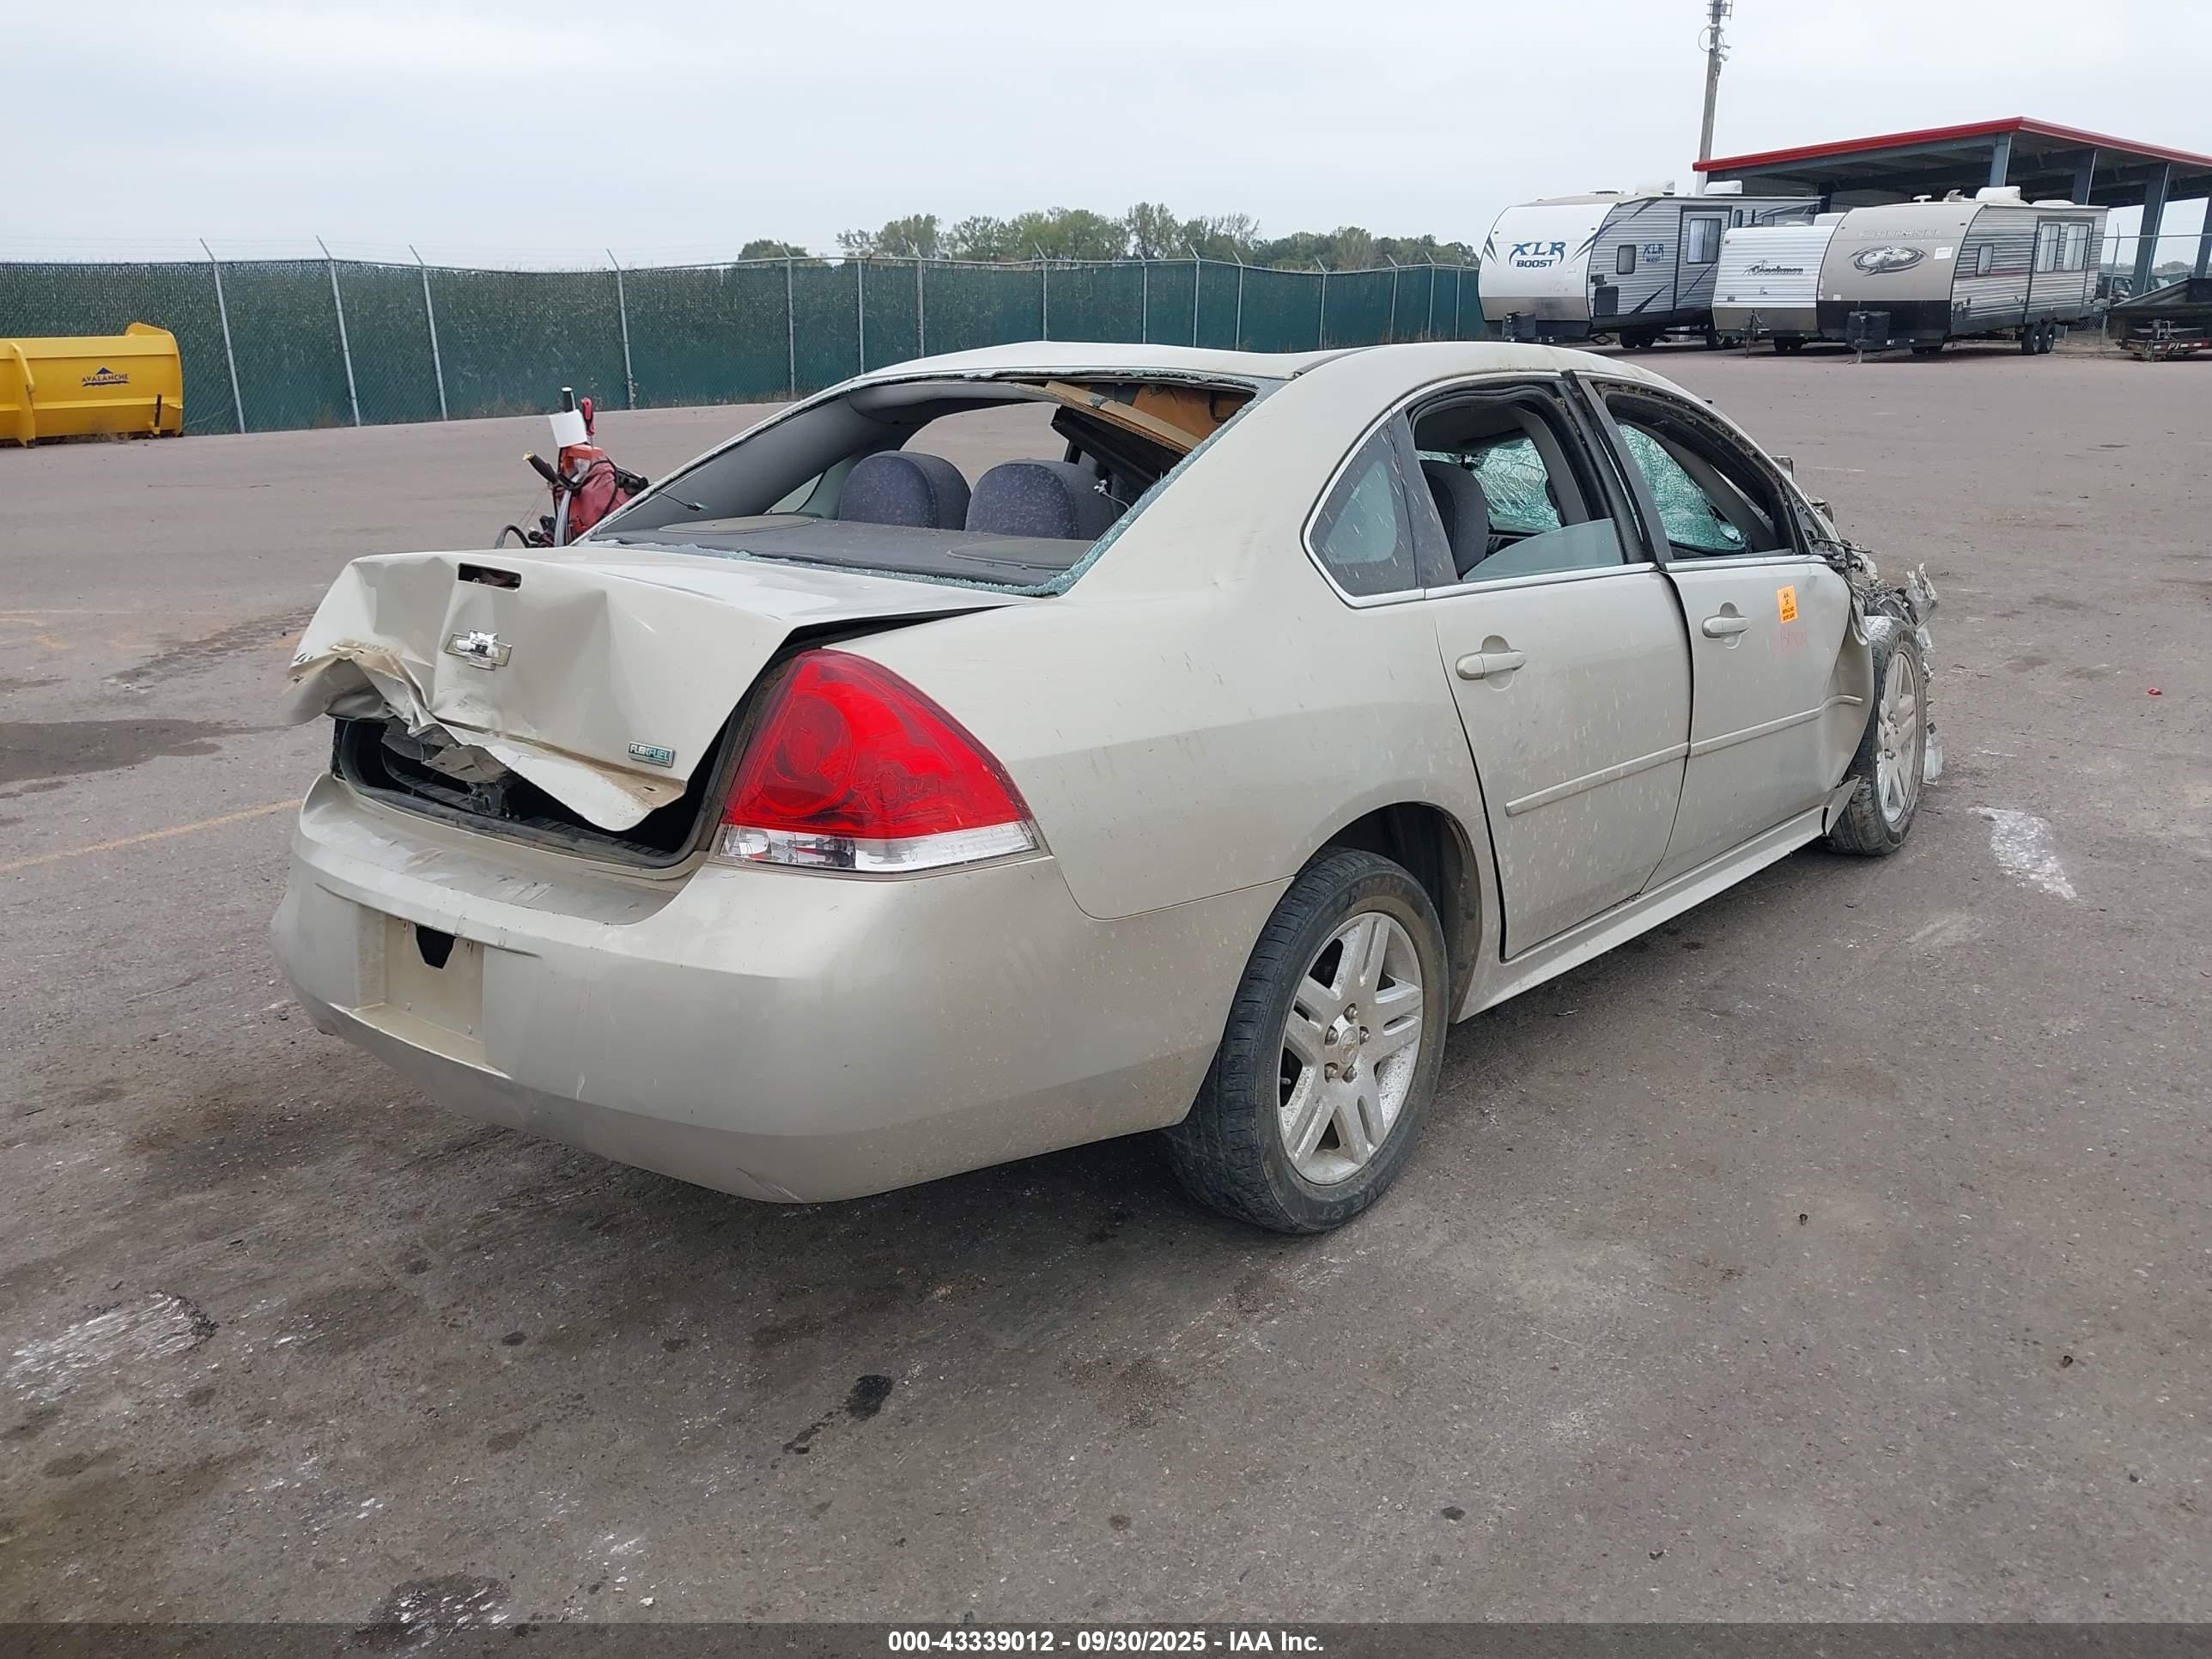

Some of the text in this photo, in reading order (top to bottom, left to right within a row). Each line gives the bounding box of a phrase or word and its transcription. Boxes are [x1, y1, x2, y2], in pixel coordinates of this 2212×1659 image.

[1509, 241, 1566, 264] XLR
[1516, 259, 1553, 268] BOOST
[82, 374, 128, 382] AVALANCHE
